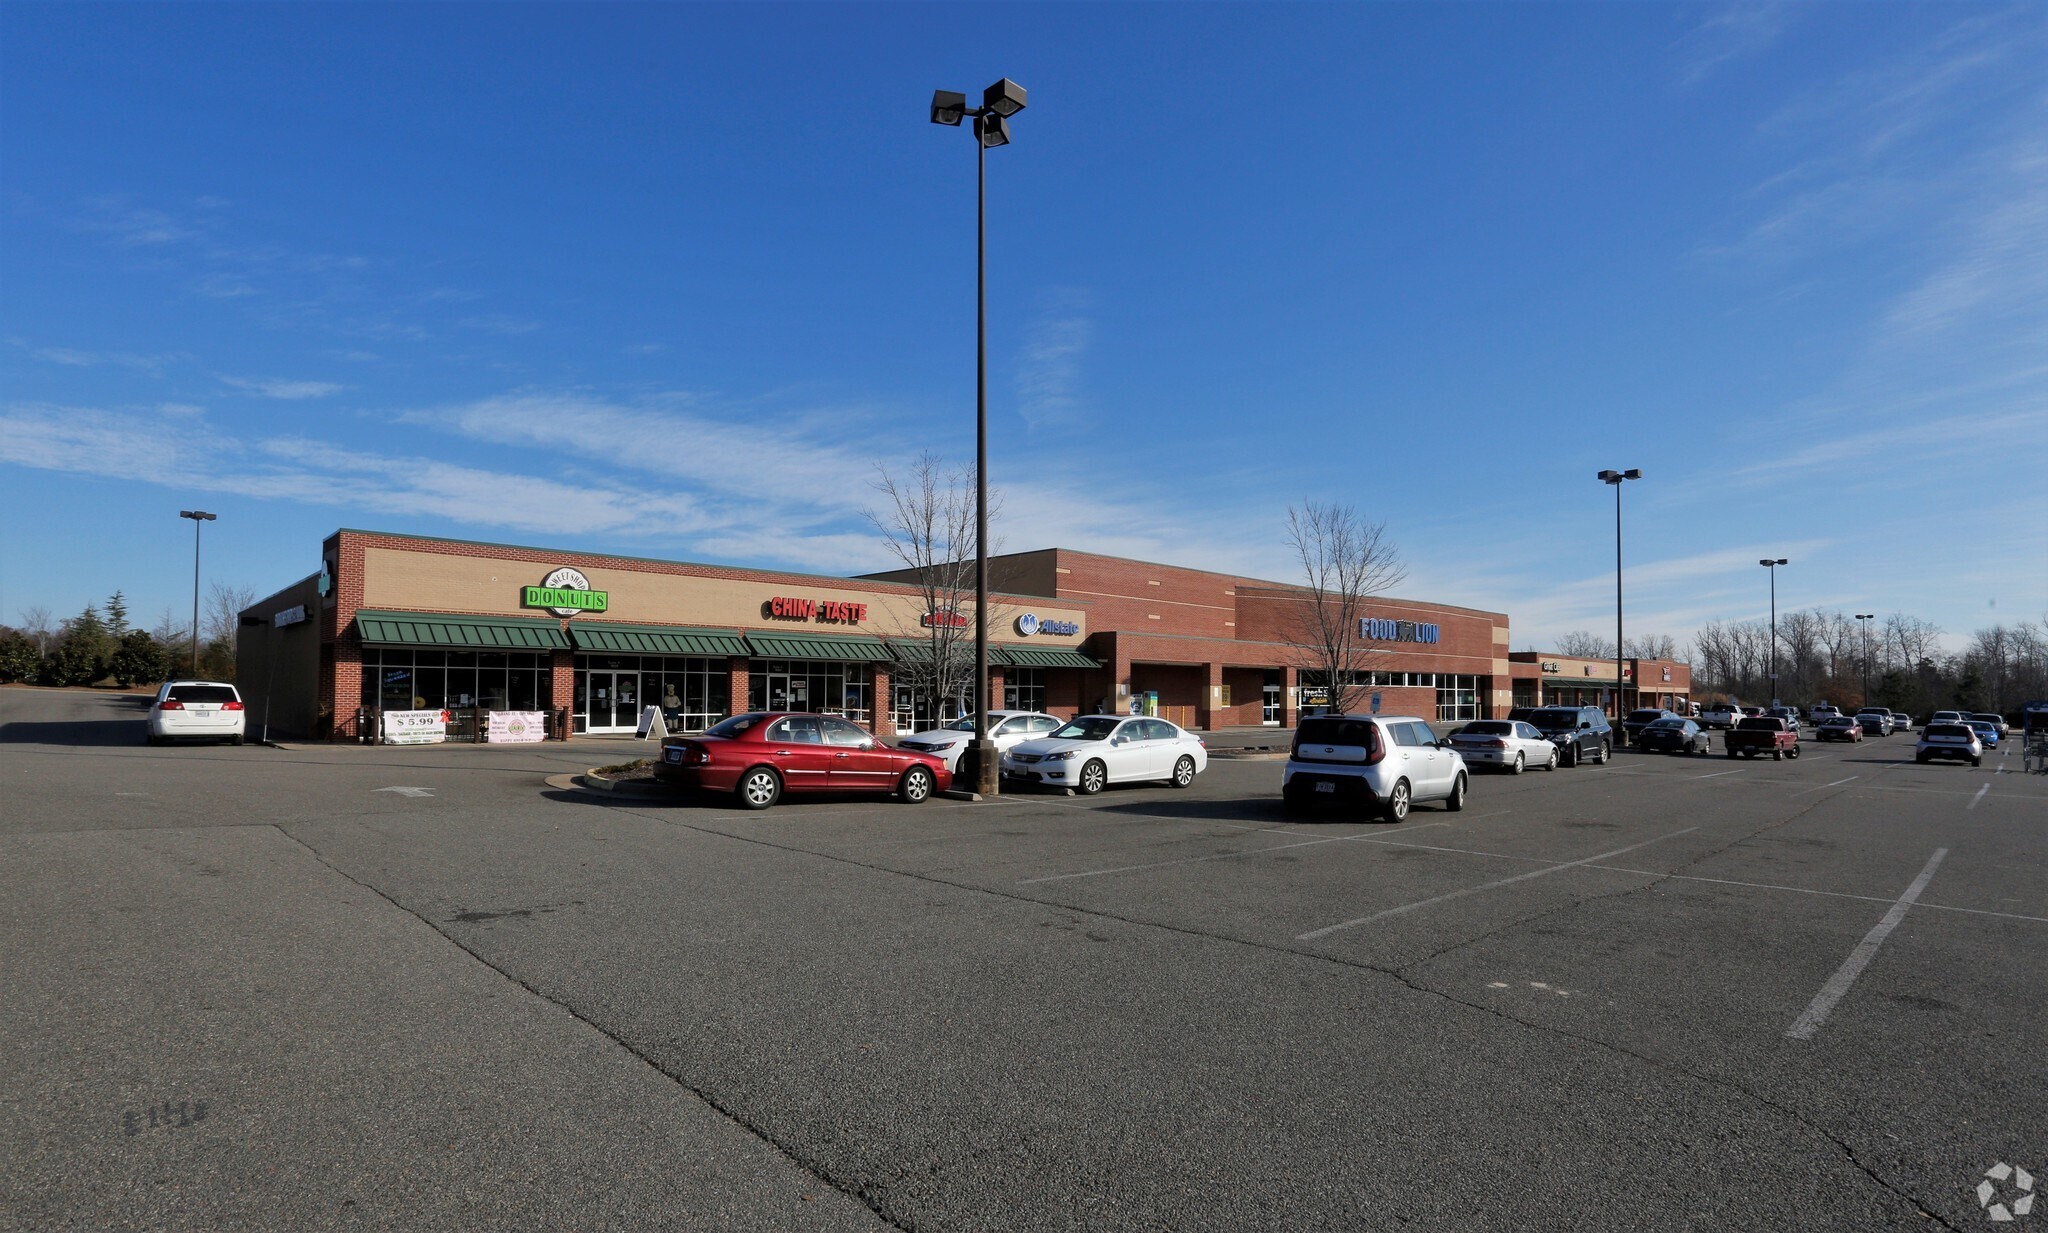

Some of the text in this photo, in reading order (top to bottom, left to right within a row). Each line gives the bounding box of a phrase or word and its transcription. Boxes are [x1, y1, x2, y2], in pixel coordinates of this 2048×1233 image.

[549, 572, 586, 590] SWEET SHOP
[529, 590, 604, 607] DONUTS
[771, 596, 867, 622] CHINA TASTE
[1040, 619, 1079, 634] Allstate
[1360, 617, 1439, 644] FOOD LION
[408, 717, 434, 726] 5.99
